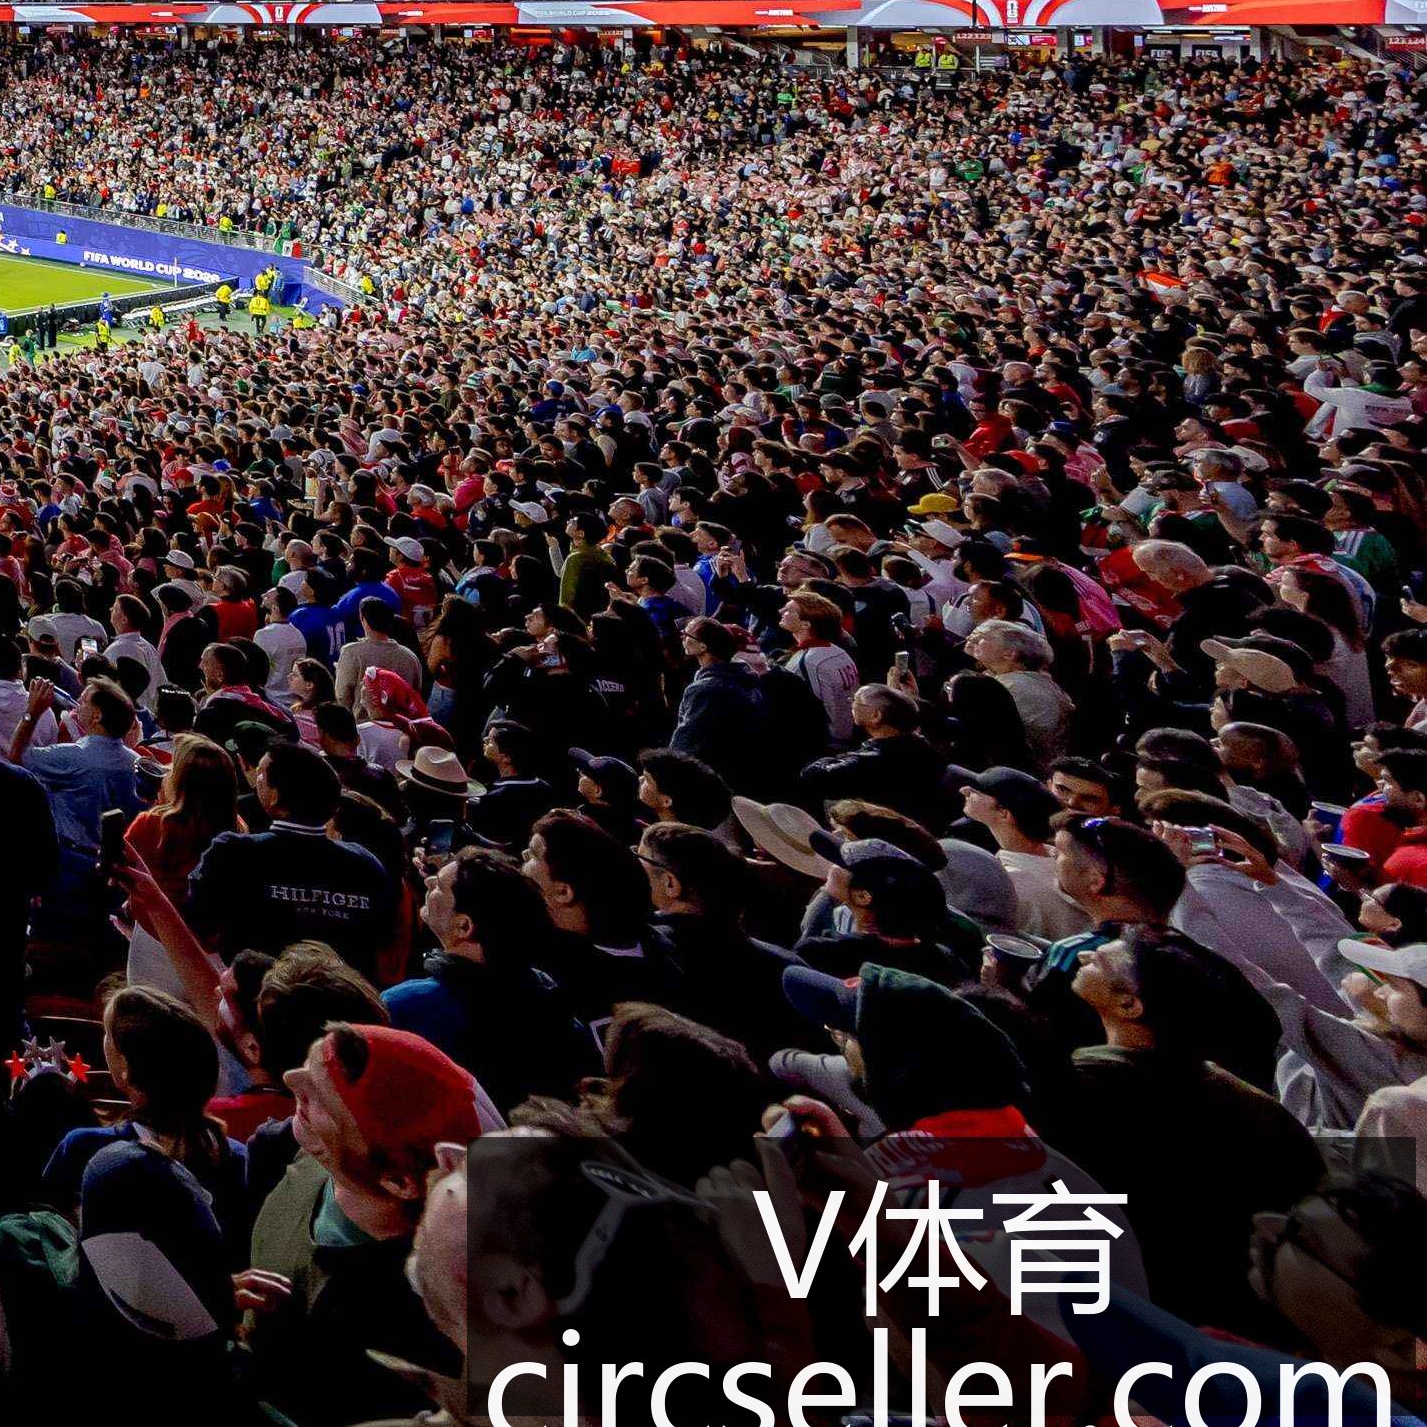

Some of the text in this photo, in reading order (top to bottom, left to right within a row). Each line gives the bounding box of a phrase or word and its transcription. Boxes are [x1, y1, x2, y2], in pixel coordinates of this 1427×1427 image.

[84, 251, 109, 264] FIFA
[110, 255, 154, 272] WORLD
[156, 262, 182, 275] CUP
[271, 885, 370, 909] HILFIGER
[321, 908, 350, 920] YORK
